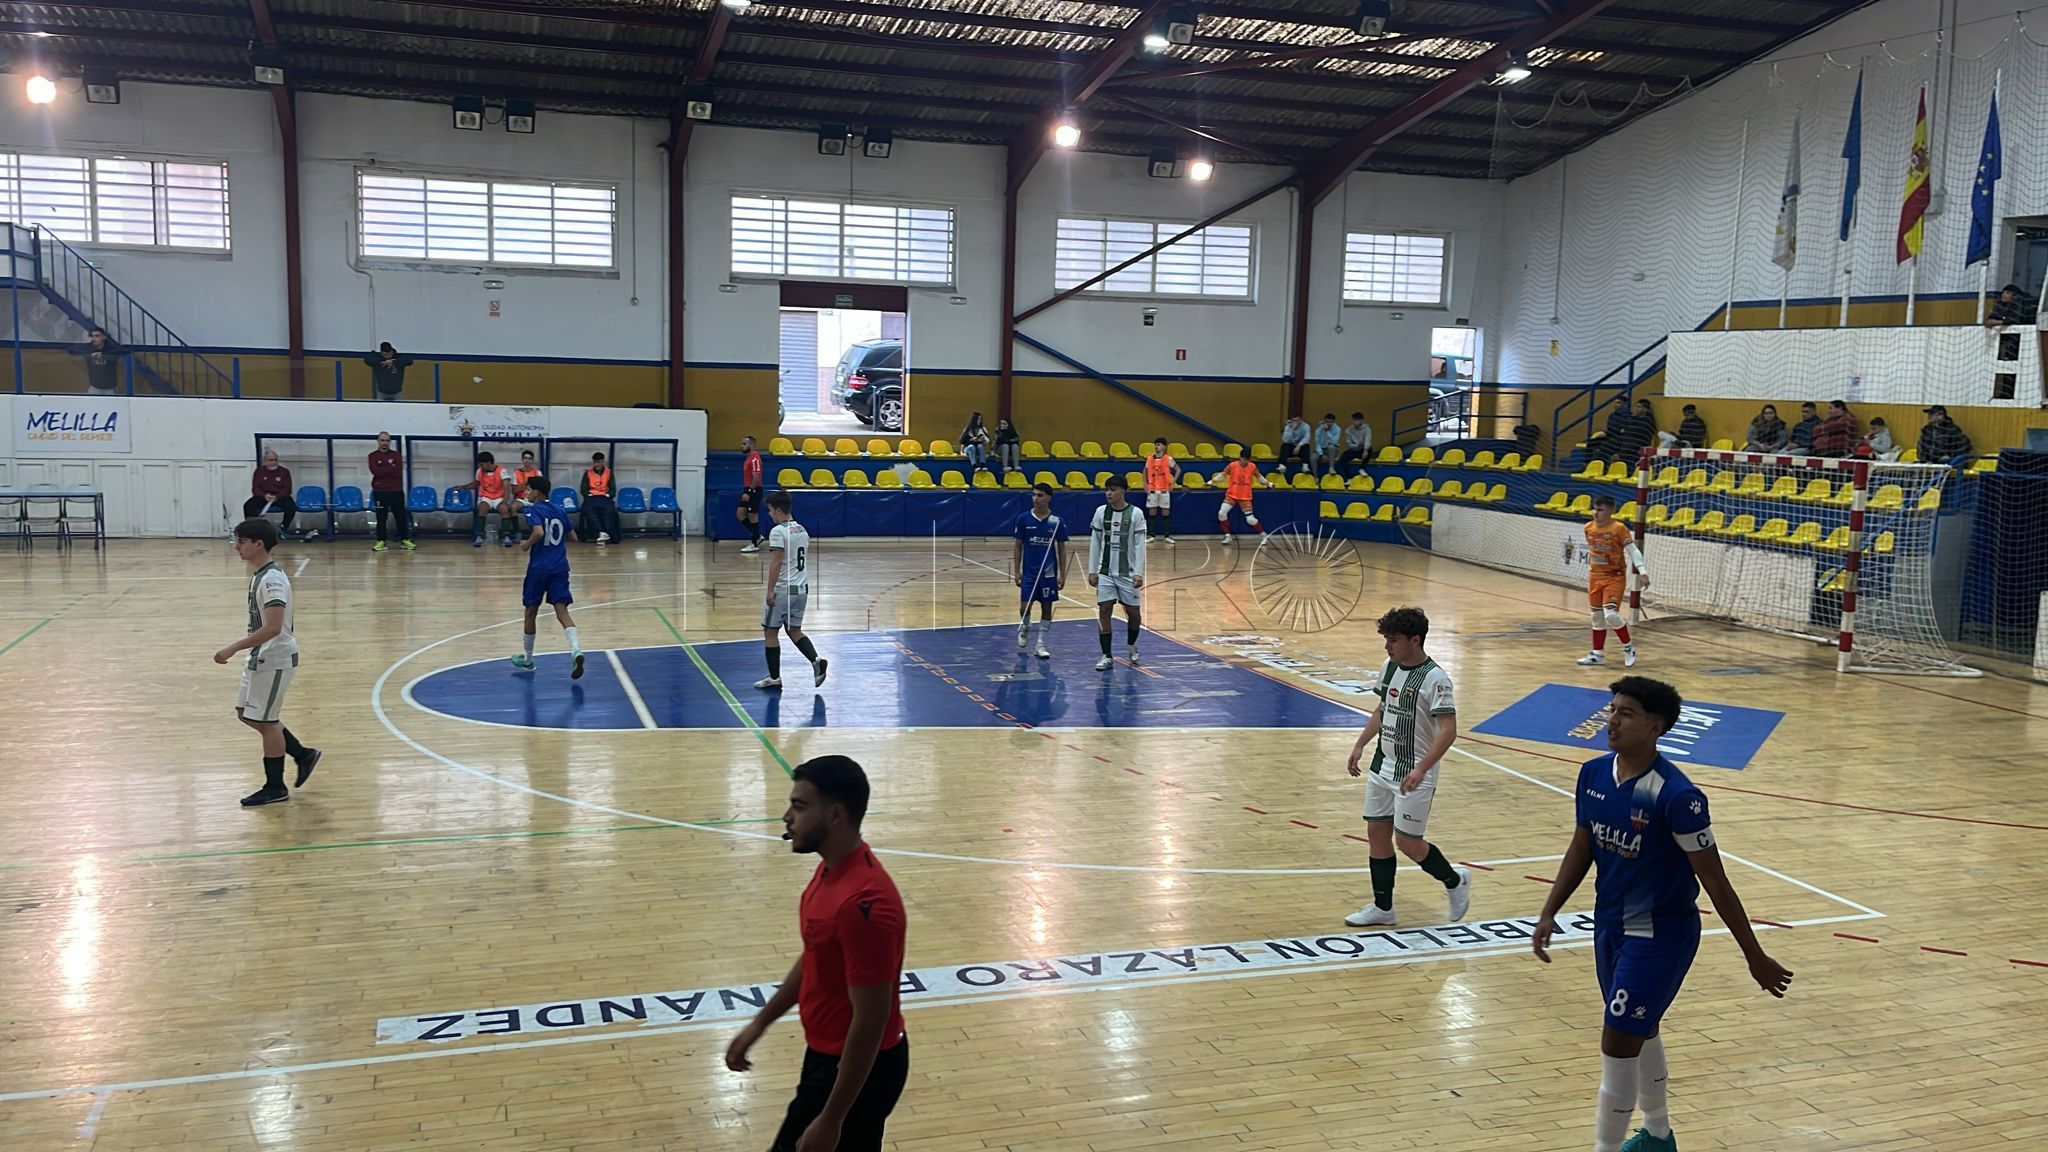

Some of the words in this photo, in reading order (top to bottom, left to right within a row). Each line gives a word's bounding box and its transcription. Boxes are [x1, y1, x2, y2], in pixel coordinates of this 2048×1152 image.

[27, 411, 118, 432] MELILLA
[543, 517, 564, 546] 10
[797, 546, 805, 572] 6
[1590, 819, 1642, 852] MELILLA
[1697, 832, 1710, 849] C
[956, 944, 1251, 987] LÁZARO
[417, 972, 928, 1041] FNÁNDEZ
[1610, 988, 1629, 1017] 8
